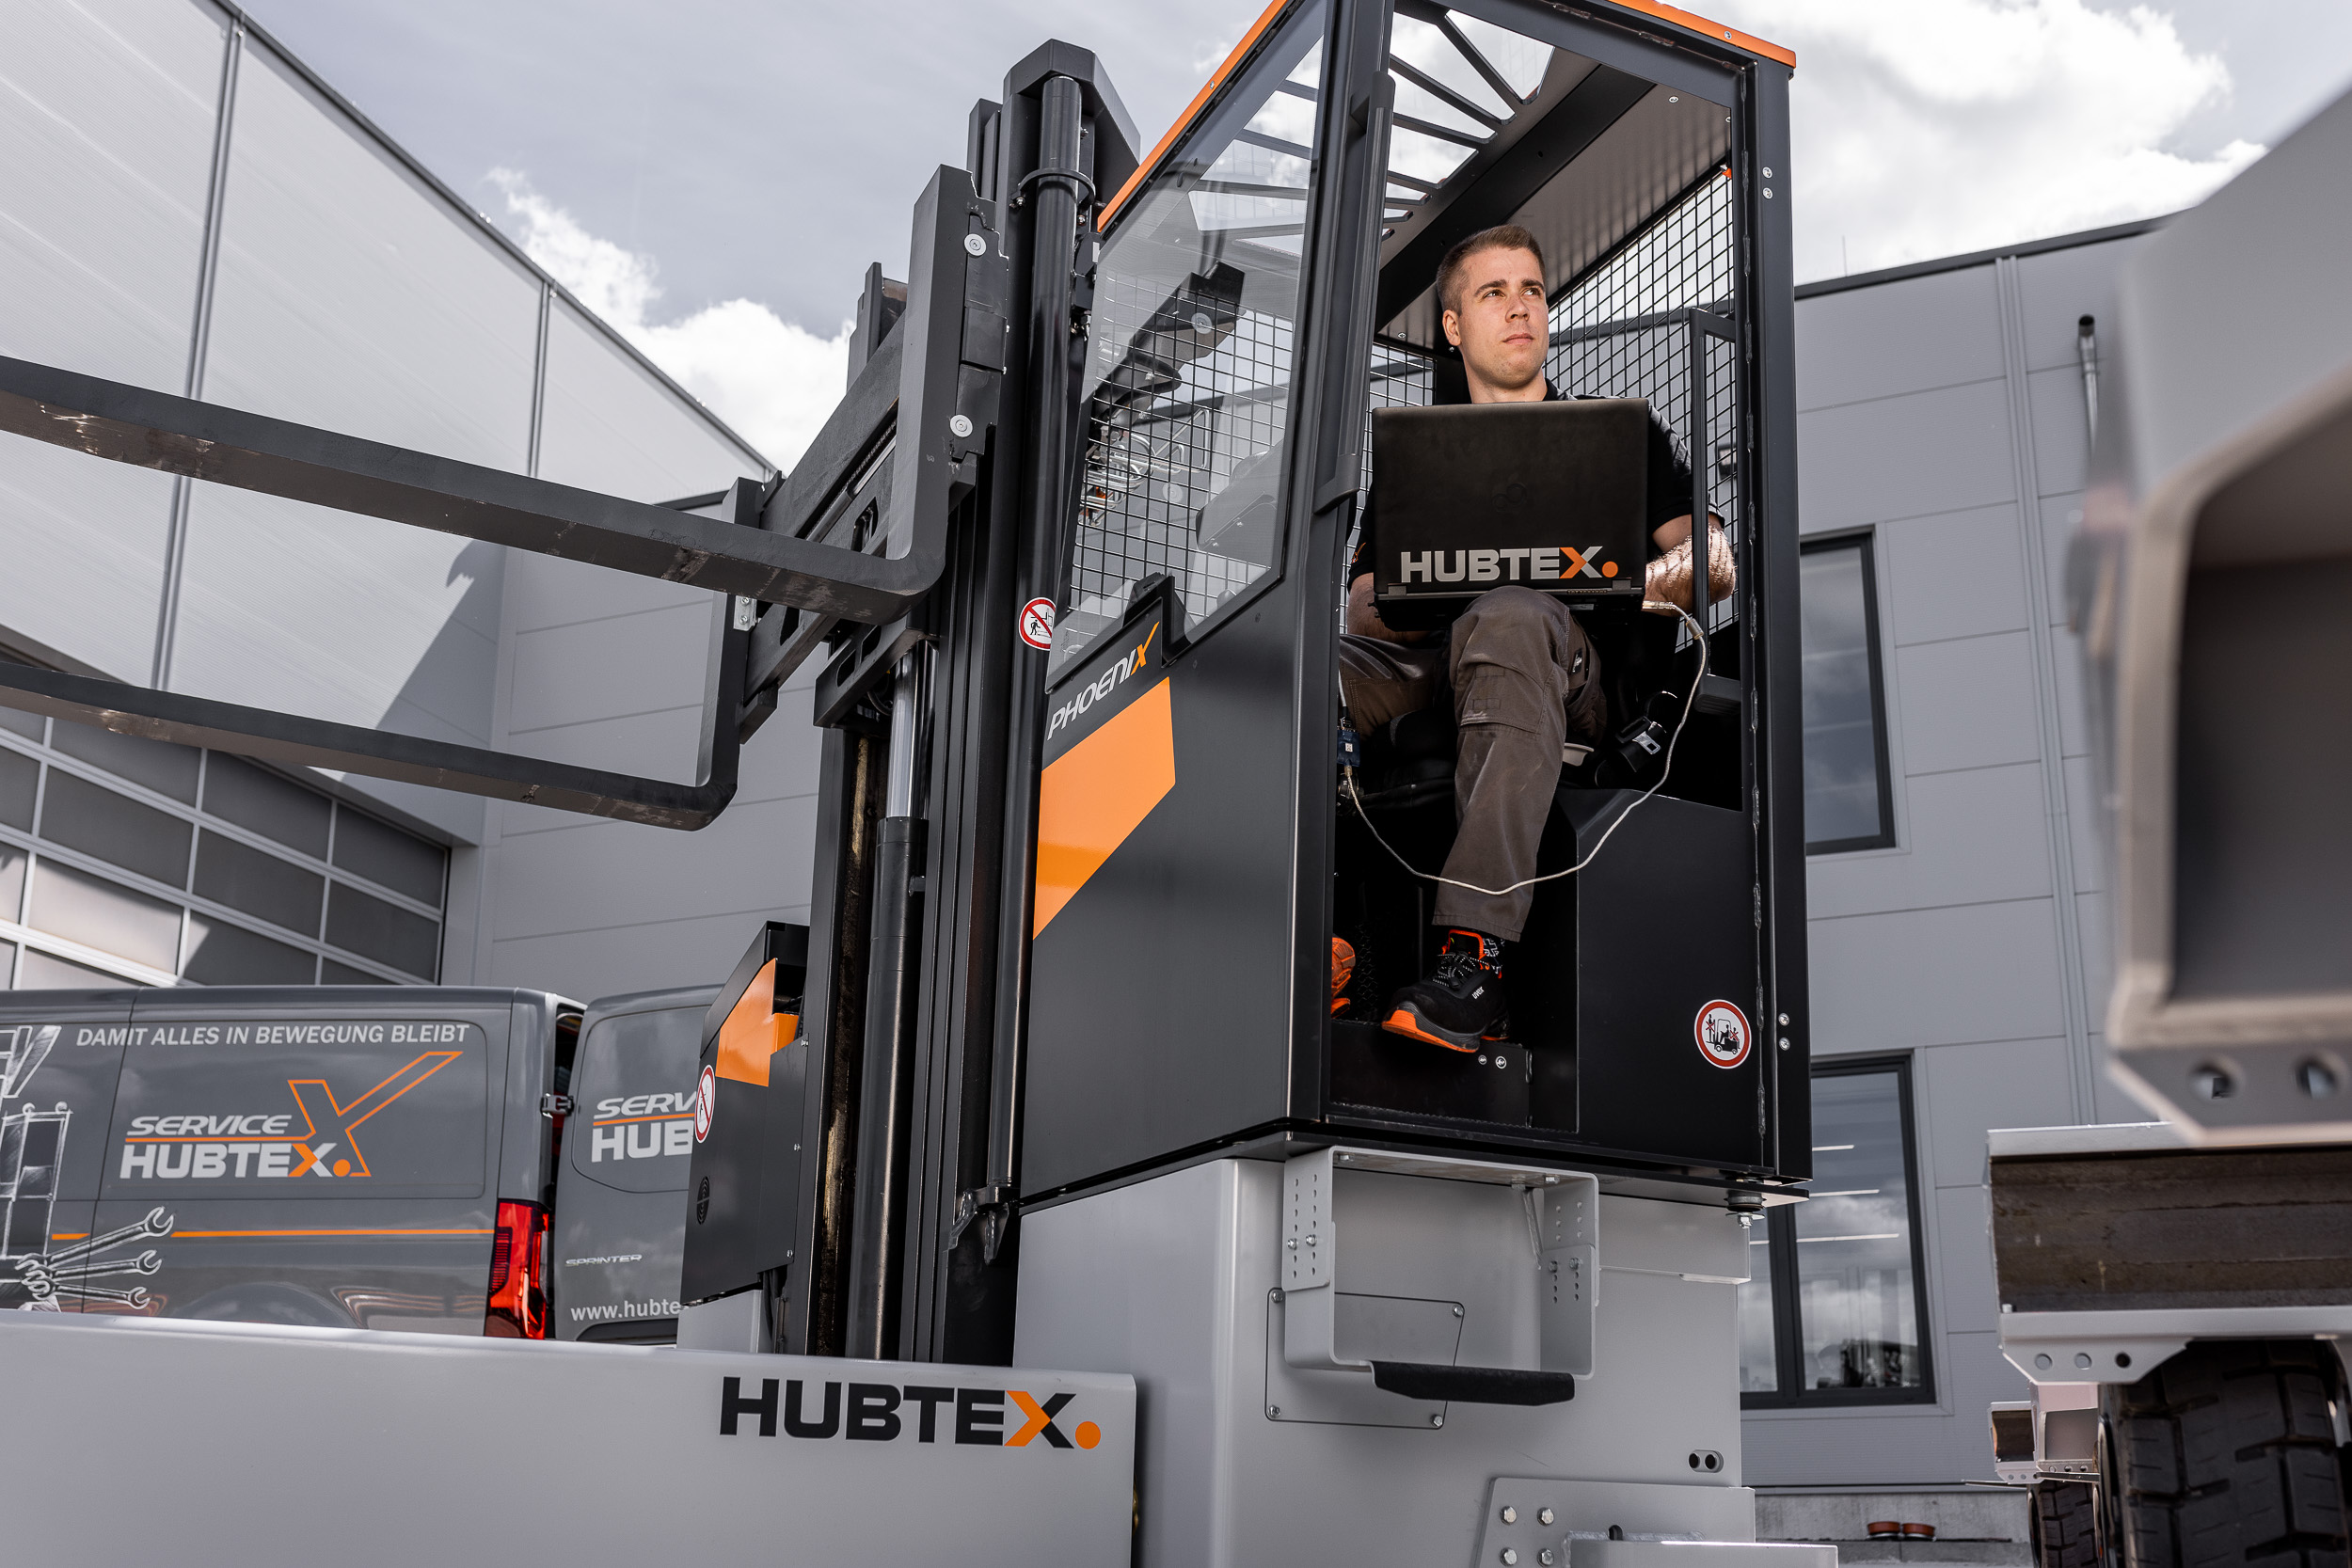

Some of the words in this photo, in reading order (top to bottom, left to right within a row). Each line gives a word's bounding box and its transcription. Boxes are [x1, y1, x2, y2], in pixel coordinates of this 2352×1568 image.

[1046, 621, 1160, 741] PHOENIX
[76, 1027, 149, 1046] DAMIT
[151, 1026, 220, 1045] ALLES
[225, 1026, 249, 1045] IN
[255, 1024, 384, 1044] BEWEGUNG
[390, 1023, 469, 1043] BLEIBT
[126, 1115, 293, 1136] SERVICE
[564, 1254, 643, 1267] SPRINTER
[570, 1298, 690, 1322] www.hubte
